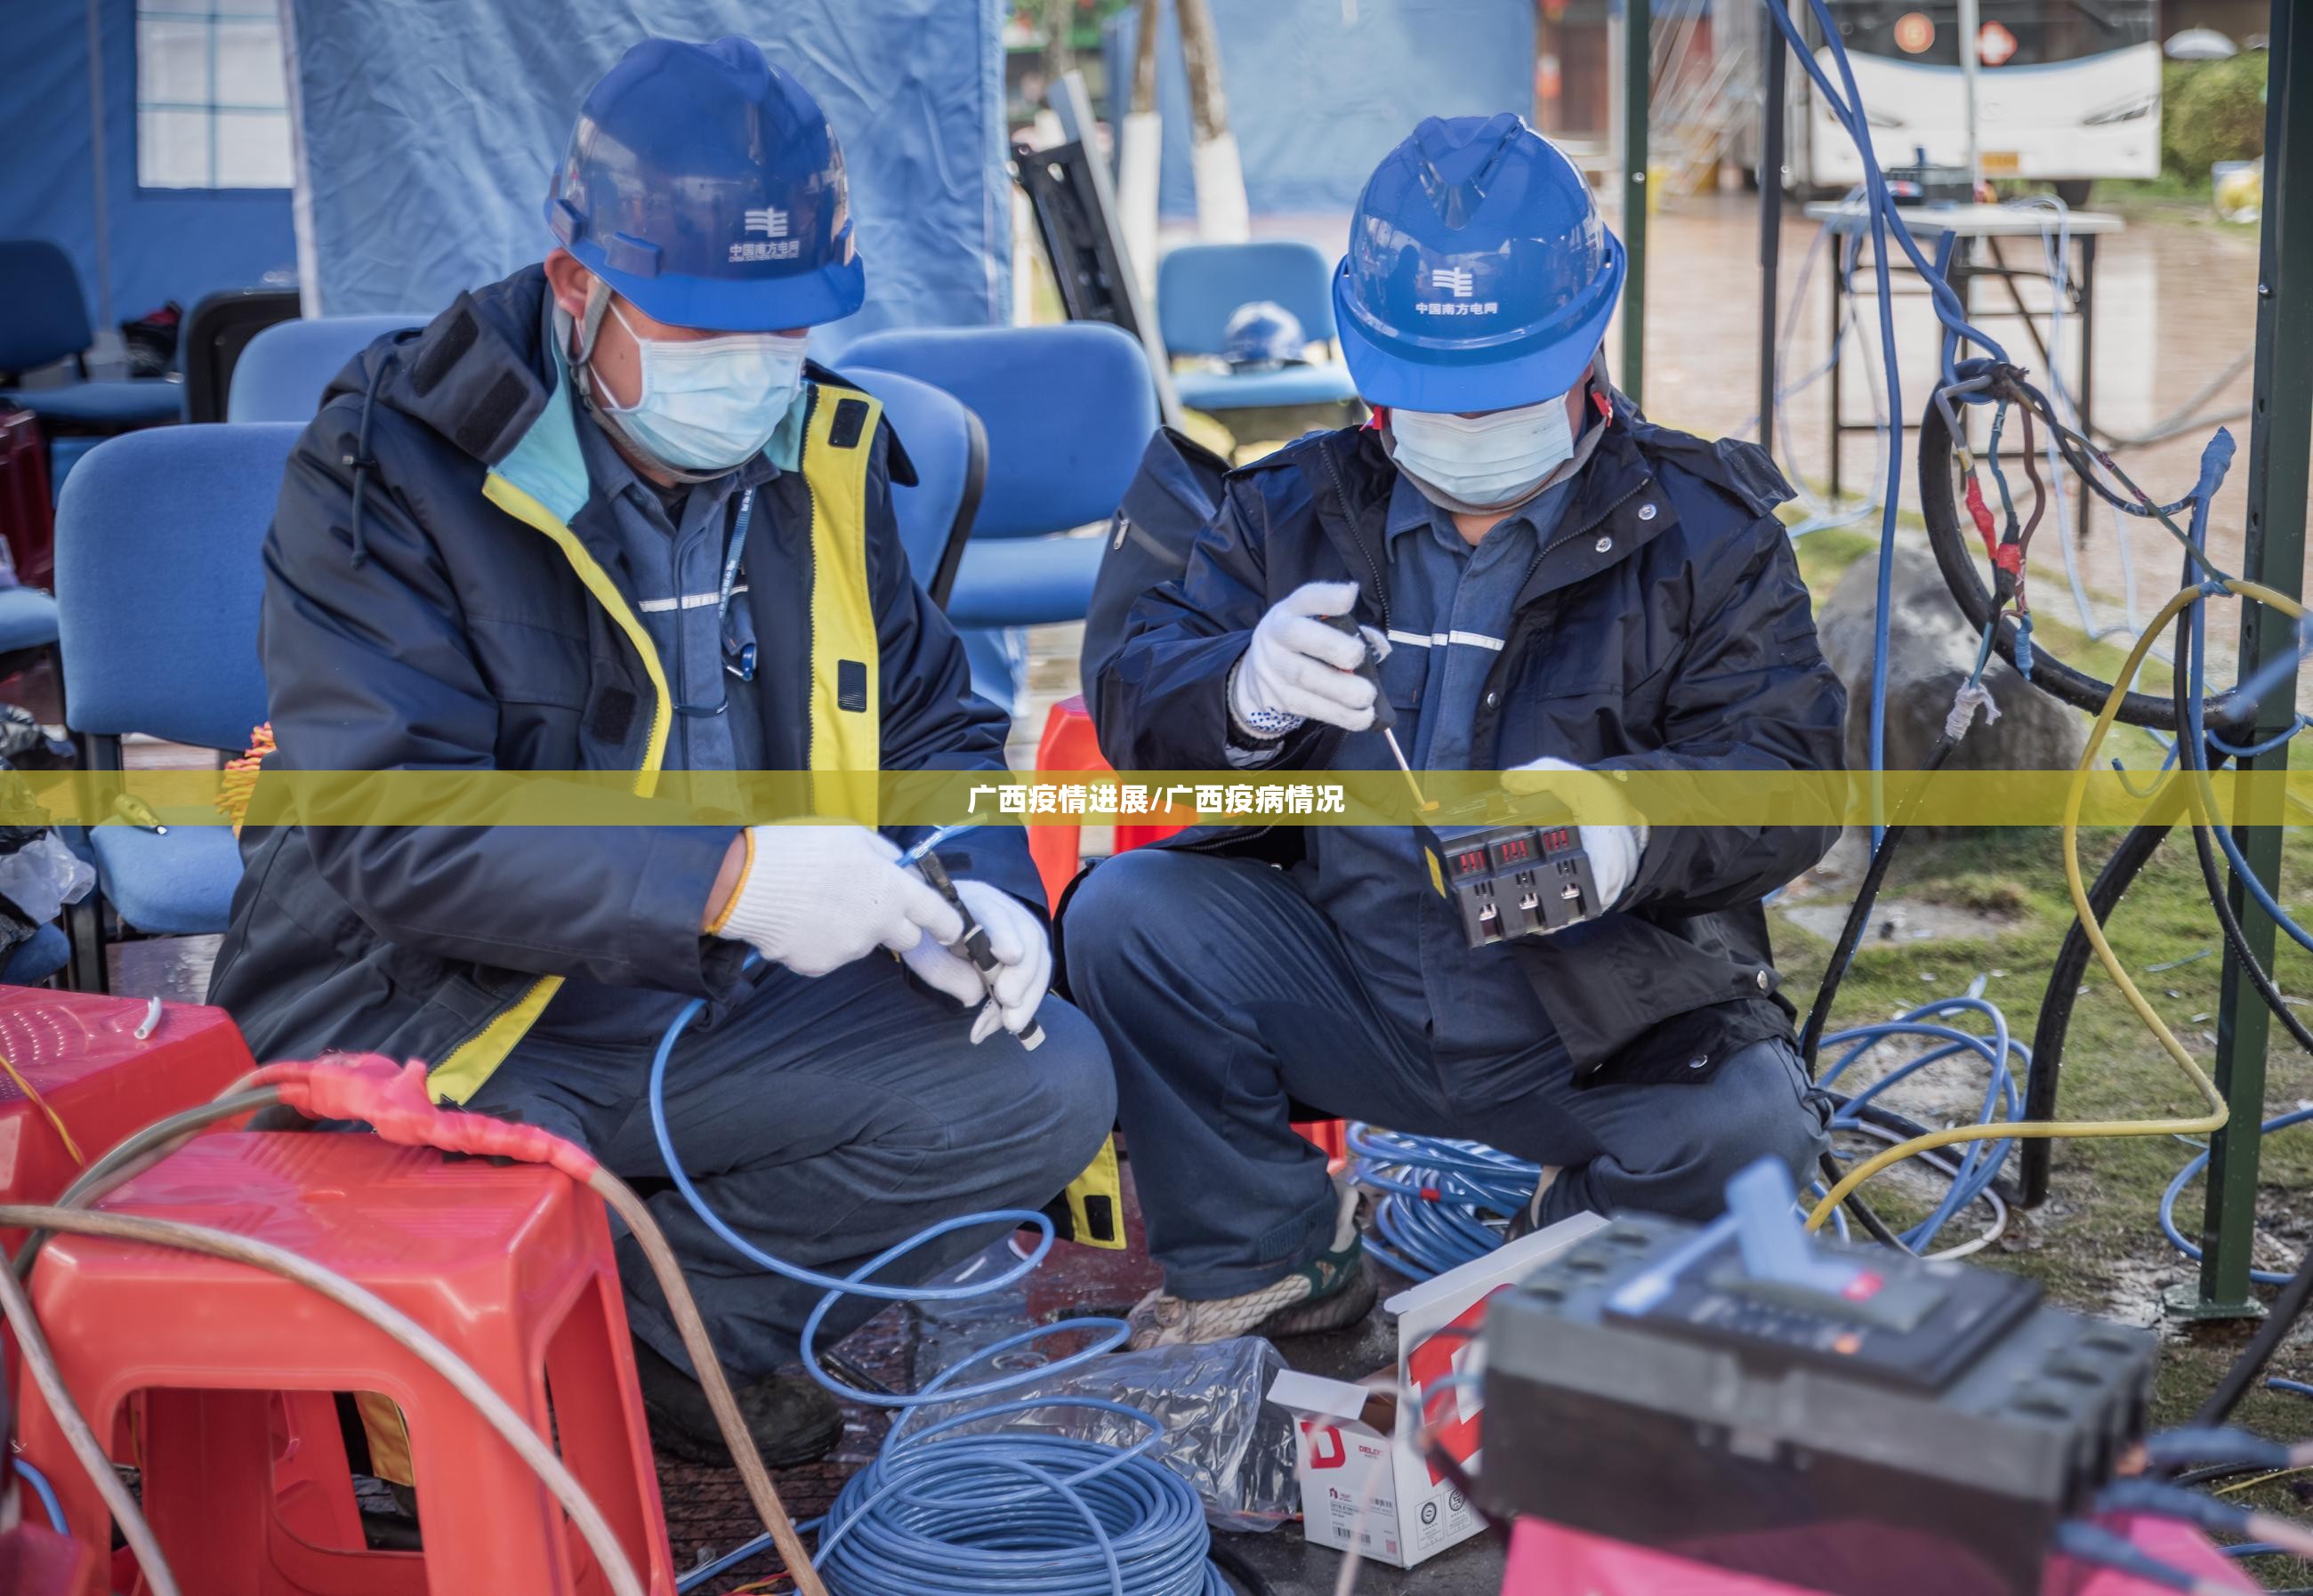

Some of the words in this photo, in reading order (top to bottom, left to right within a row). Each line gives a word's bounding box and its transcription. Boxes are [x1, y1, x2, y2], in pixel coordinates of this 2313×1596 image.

[729, 240, 799, 256] 中国南方电网
[1415, 302, 1498, 316] 中国南方电网
